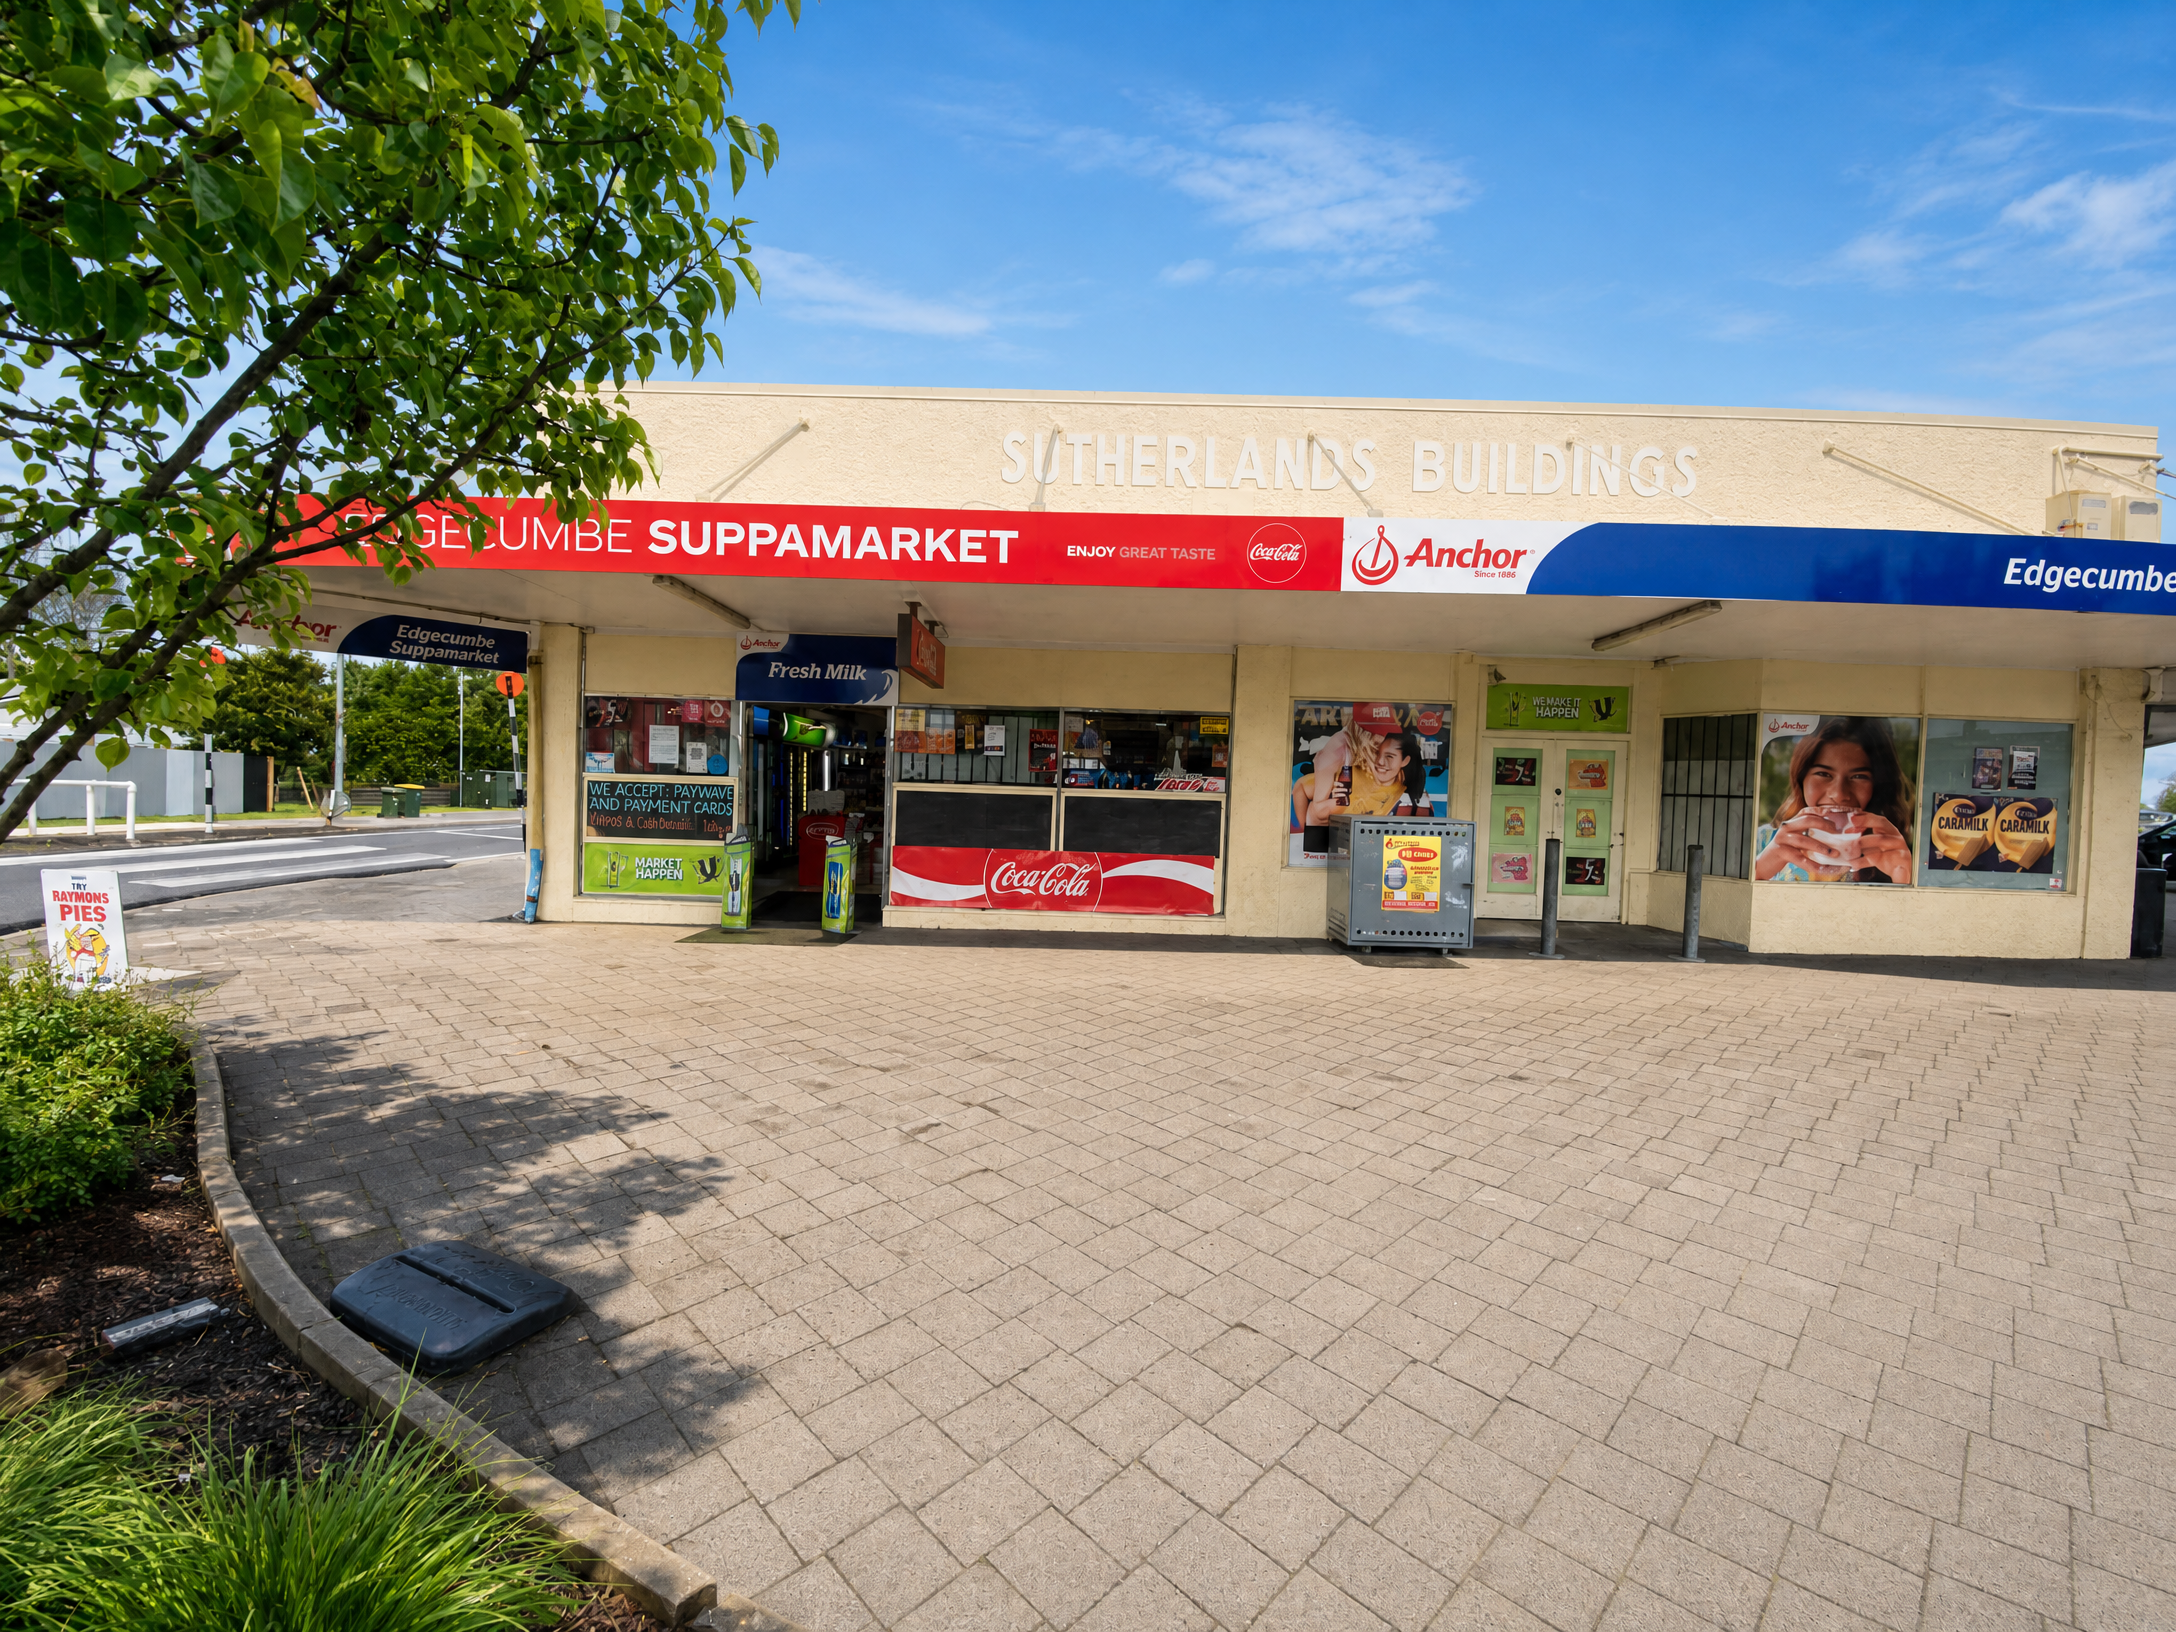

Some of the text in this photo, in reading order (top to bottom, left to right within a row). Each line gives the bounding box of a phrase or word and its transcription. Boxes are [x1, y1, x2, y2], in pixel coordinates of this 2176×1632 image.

[1000, 430, 1698, 498] SUTHERLANDS BUILDINGS
[648, 519, 1019, 564] SUPPAMARKET
[1067, 545, 1216, 560] ENJOY GREAT TASTE
[1249, 542, 1303, 561] Coca-Cola
[1403, 538, 1528, 569] Anchor
[1474, 570, 1517, 579] Since 1886
[2003, 557, 2176, 593] Edgecumbe
[396, 624, 496, 649] Edgecumbe
[389, 640, 500, 664] Suppamarket
[768, 661, 868, 681] Fresh Milk
[1536, 706, 1579, 718] HAPPEN
[1780, 721, 1810, 730] Anchor
[589, 782, 735, 800] WE ACCEPT: PAYWAVE
[589, 797, 733, 816] AND PAYMENT CARDS
[1938, 816, 1989, 831] CARAMILK
[2000, 819, 2050, 834] CARAMILK
[635, 868, 683, 880] HAPPEN
[990, 861, 1097, 897] Coca-Cola
[71, 882, 87, 891] TRY
[52, 890, 109, 904] RAYMONS
[59, 904, 107, 922] PIES
